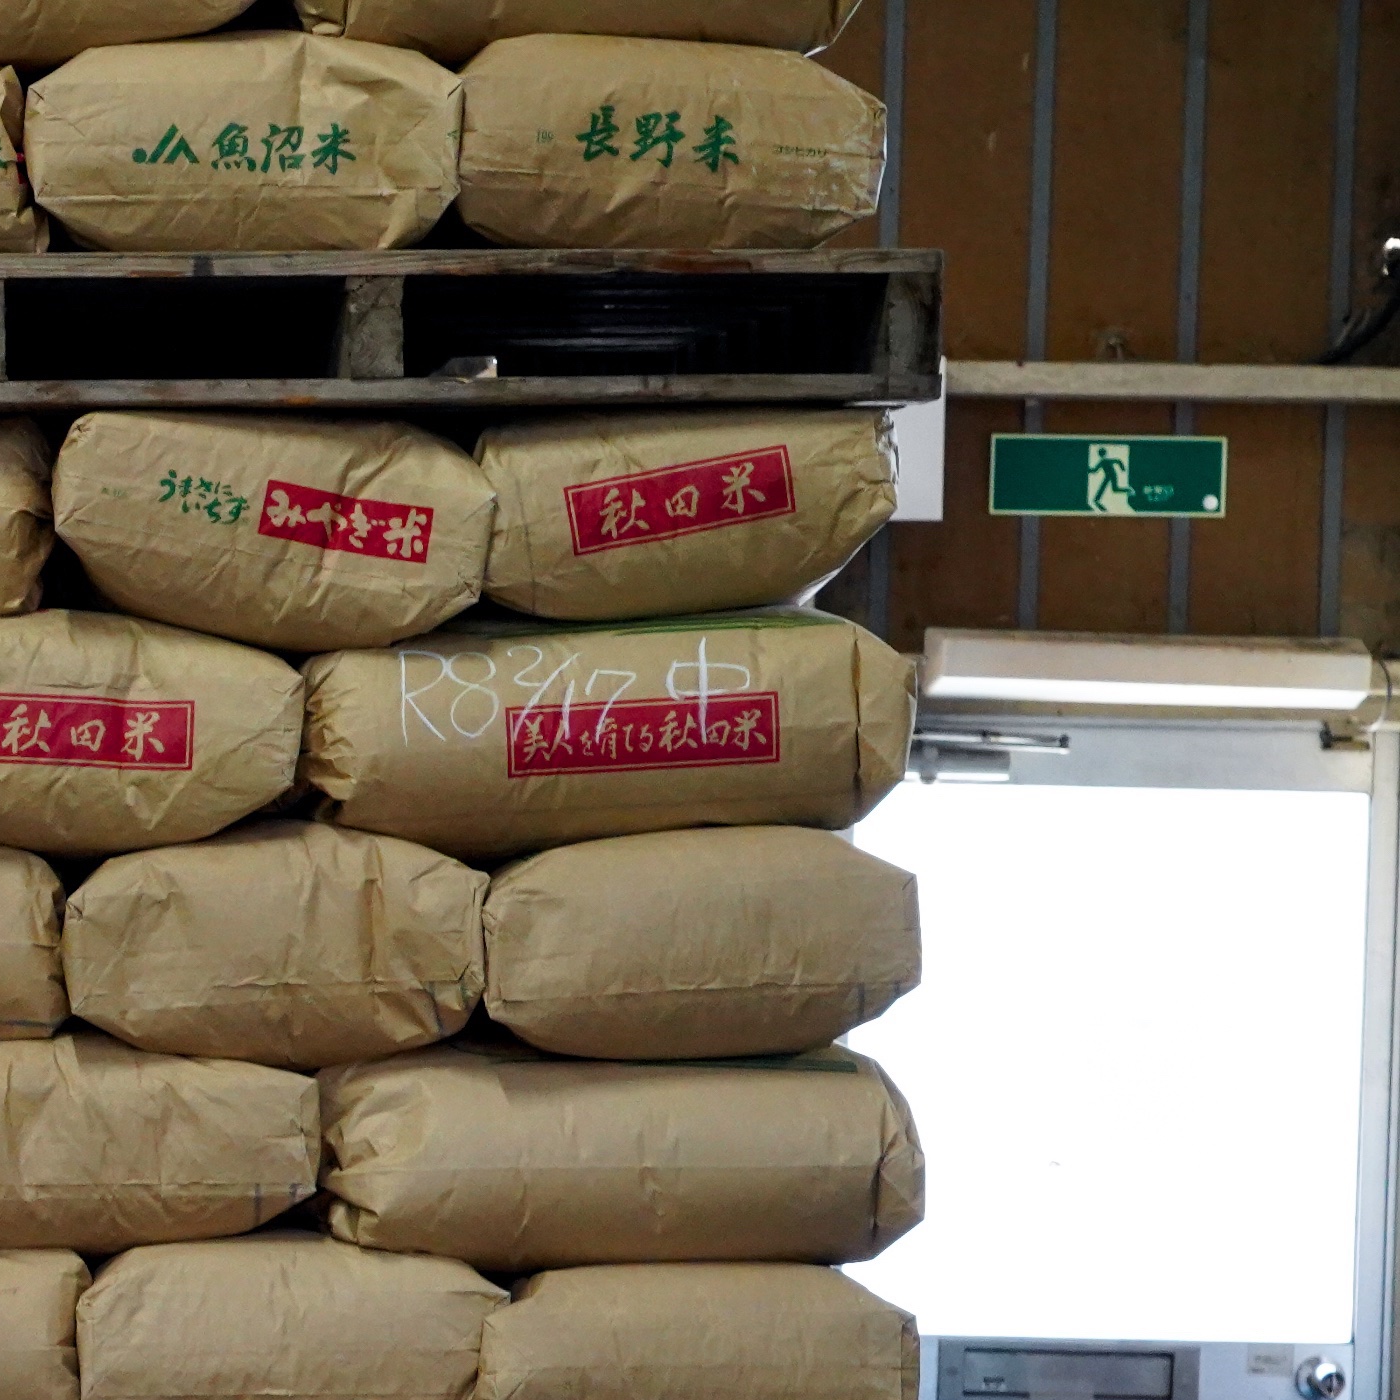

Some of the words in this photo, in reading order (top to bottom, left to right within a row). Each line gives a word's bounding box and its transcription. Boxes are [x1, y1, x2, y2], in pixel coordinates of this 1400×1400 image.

[210, 122, 358, 175] 魚沼米
[576, 105, 740, 173] 長野米
[270, 488, 433, 560] みやぎ米
[599, 464, 767, 541] 秋田米
[401, 648, 497, 746] R8
[665, 637, 750, 744] 中
[0, 704, 164, 760] 秋田米
